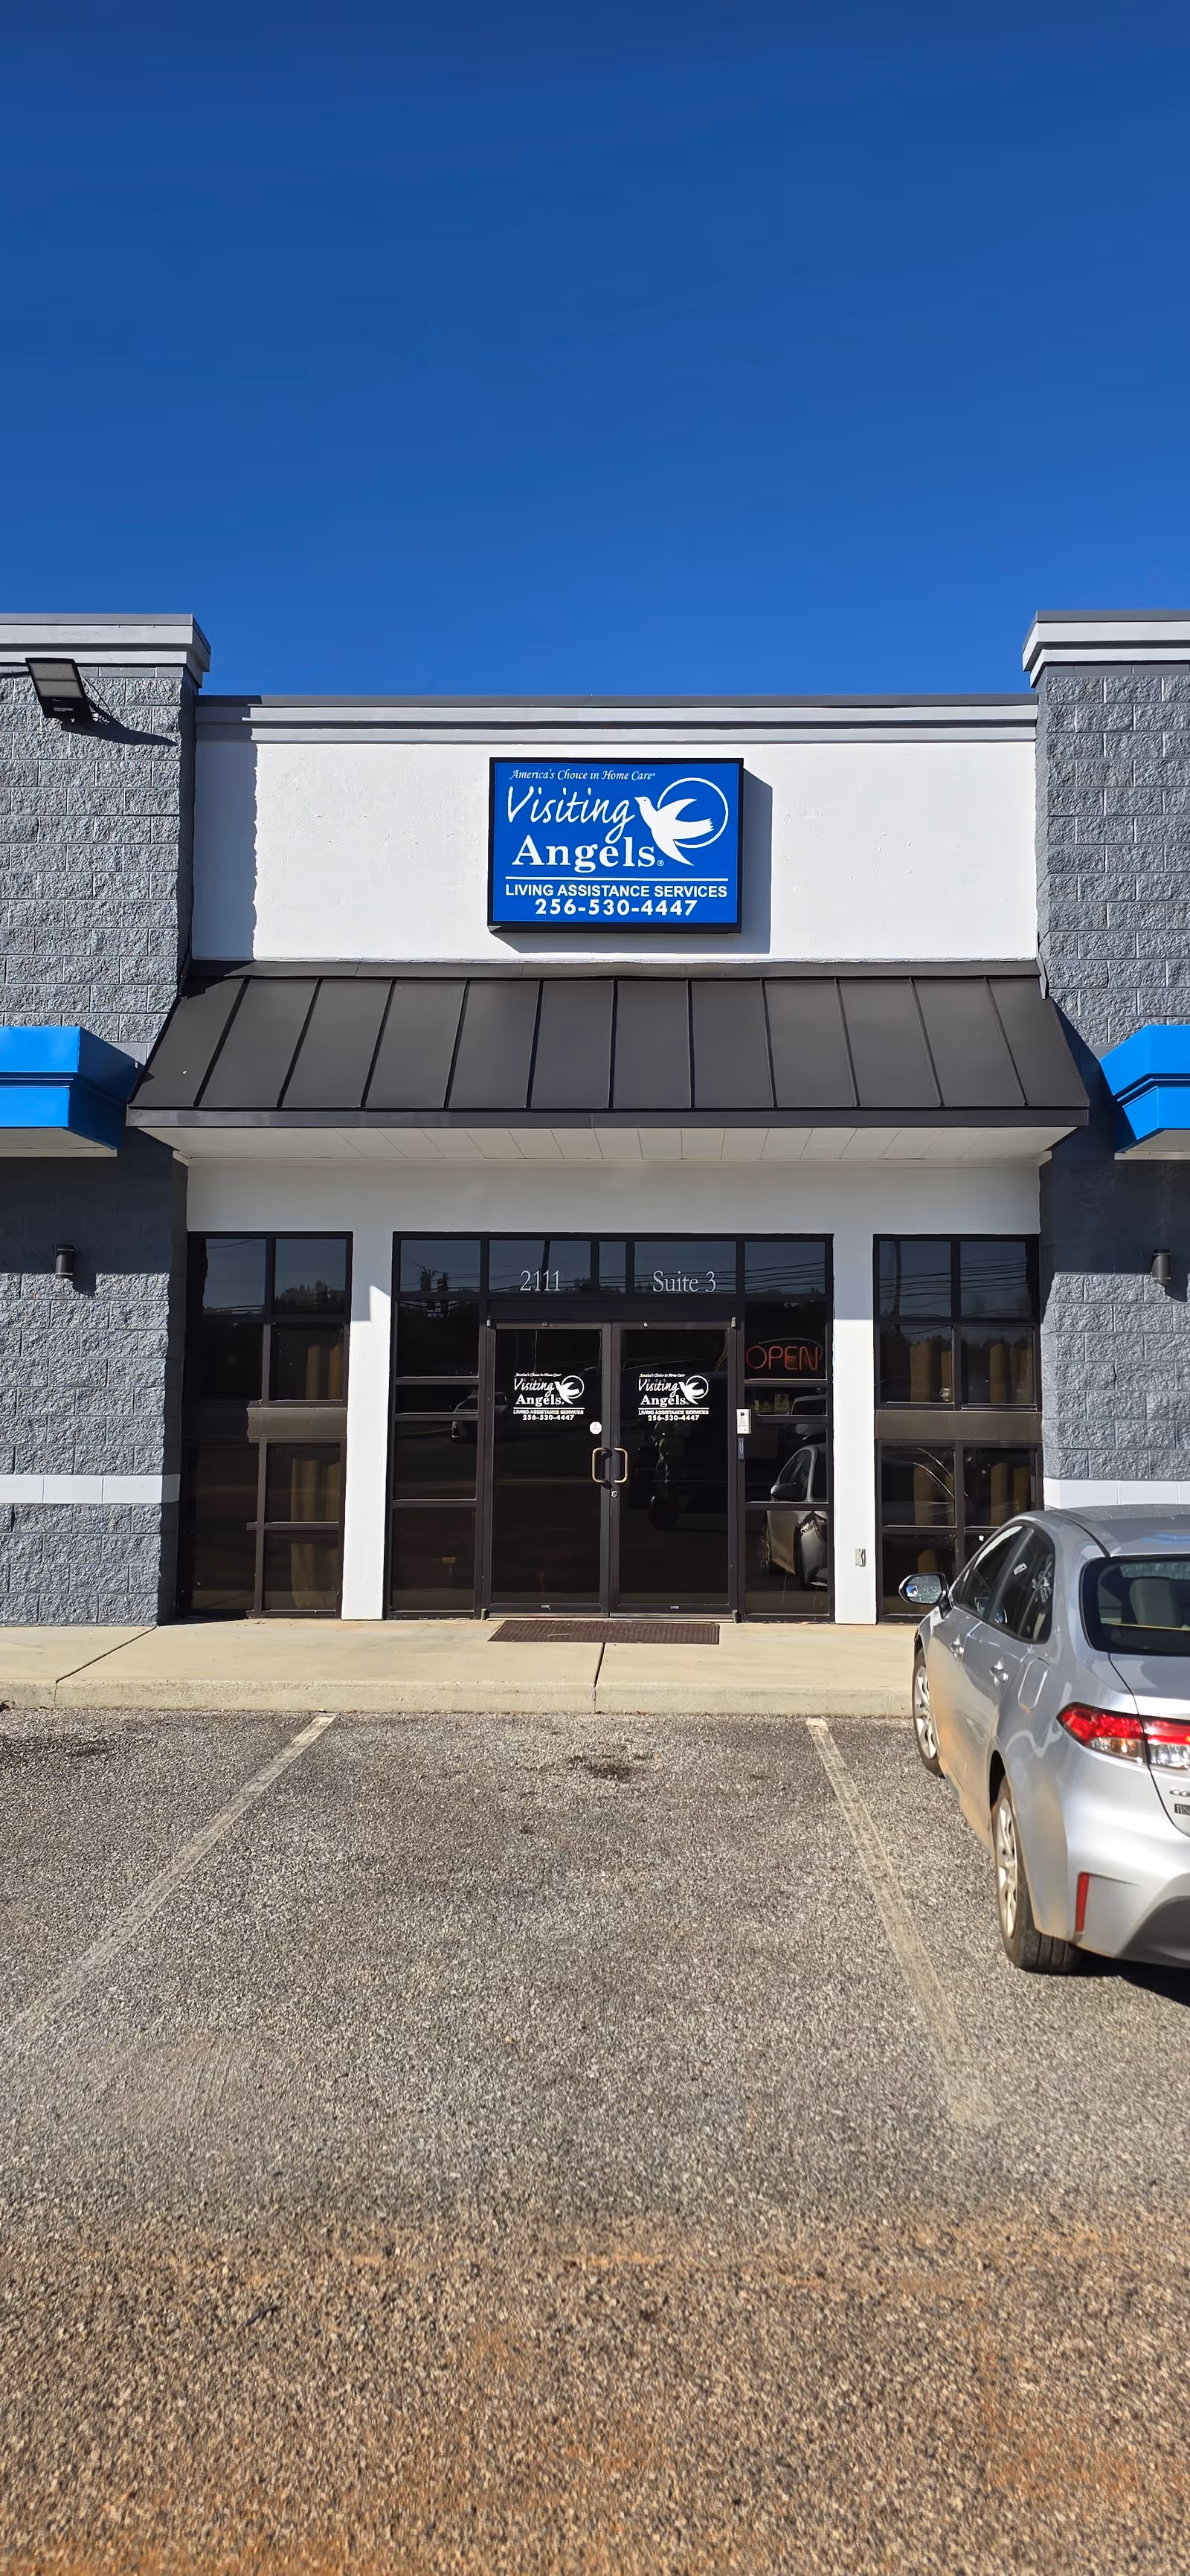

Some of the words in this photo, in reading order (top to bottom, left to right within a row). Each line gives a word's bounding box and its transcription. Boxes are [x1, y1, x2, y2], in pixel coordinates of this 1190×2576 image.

[509, 769, 556, 780] America's
[557, 768, 588, 780] Choice
[590, 770, 599, 780] in
[602, 770, 629, 780] Home
[507, 786, 636, 844] Visiting
[506, 884, 554, 896] LIVING
[557, 884, 650, 897] ASSISTANCE
[654, 885, 727, 898] SERVICES
[535, 898, 698, 916] 256-530-4447
[520, 1270, 561, 1291] 2111
[652, 1270, 699, 1293] Suite
[705, 1271, 716, 1293] 3
[746, 1345, 819, 1370] OPEN
[514, 1378, 555, 1397] Visiting
[638, 1378, 680, 1397] Visiting
